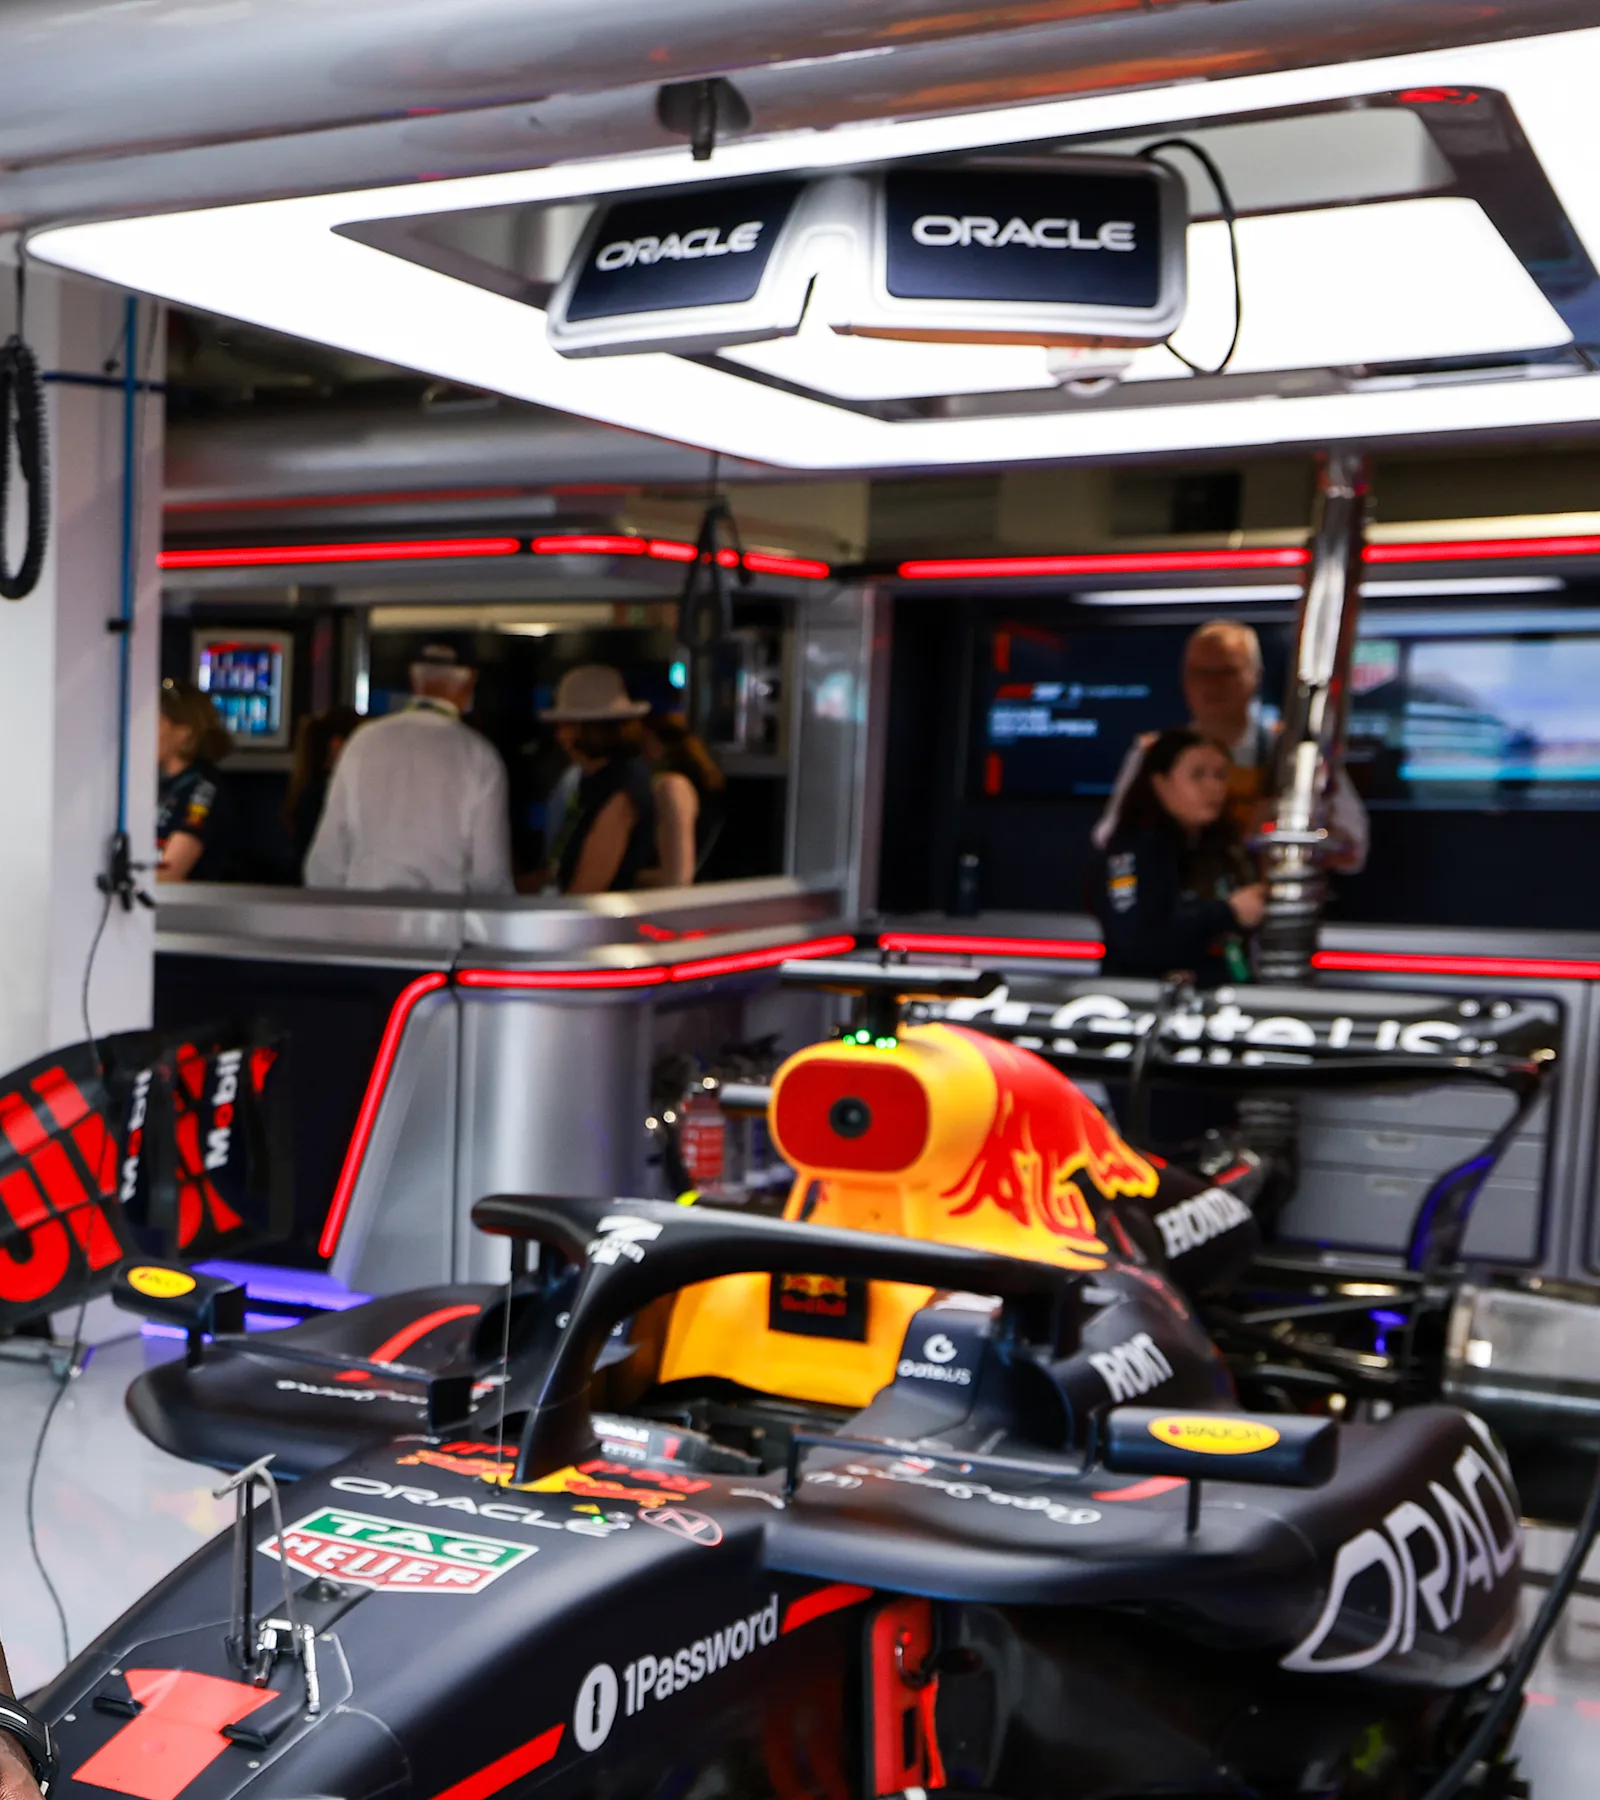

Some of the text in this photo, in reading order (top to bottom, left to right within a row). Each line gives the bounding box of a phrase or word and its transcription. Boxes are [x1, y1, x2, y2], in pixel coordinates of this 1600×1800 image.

[595, 221, 763, 272] ORACLE
[912, 215, 1136, 252] ORACLE
[120, 1068, 153, 1203] Mobil
[205, 1049, 242, 1170] Mobil
[1154, 1187, 1252, 1259] HONDA
[1185, 1425, 1262, 1441] RAUCH
[330, 1475, 615, 1538] ORACLE
[284, 1535, 482, 1585] HEUER
[328, 1515, 507, 1564] TAG
[622, 1593, 779, 1717] 1Password
